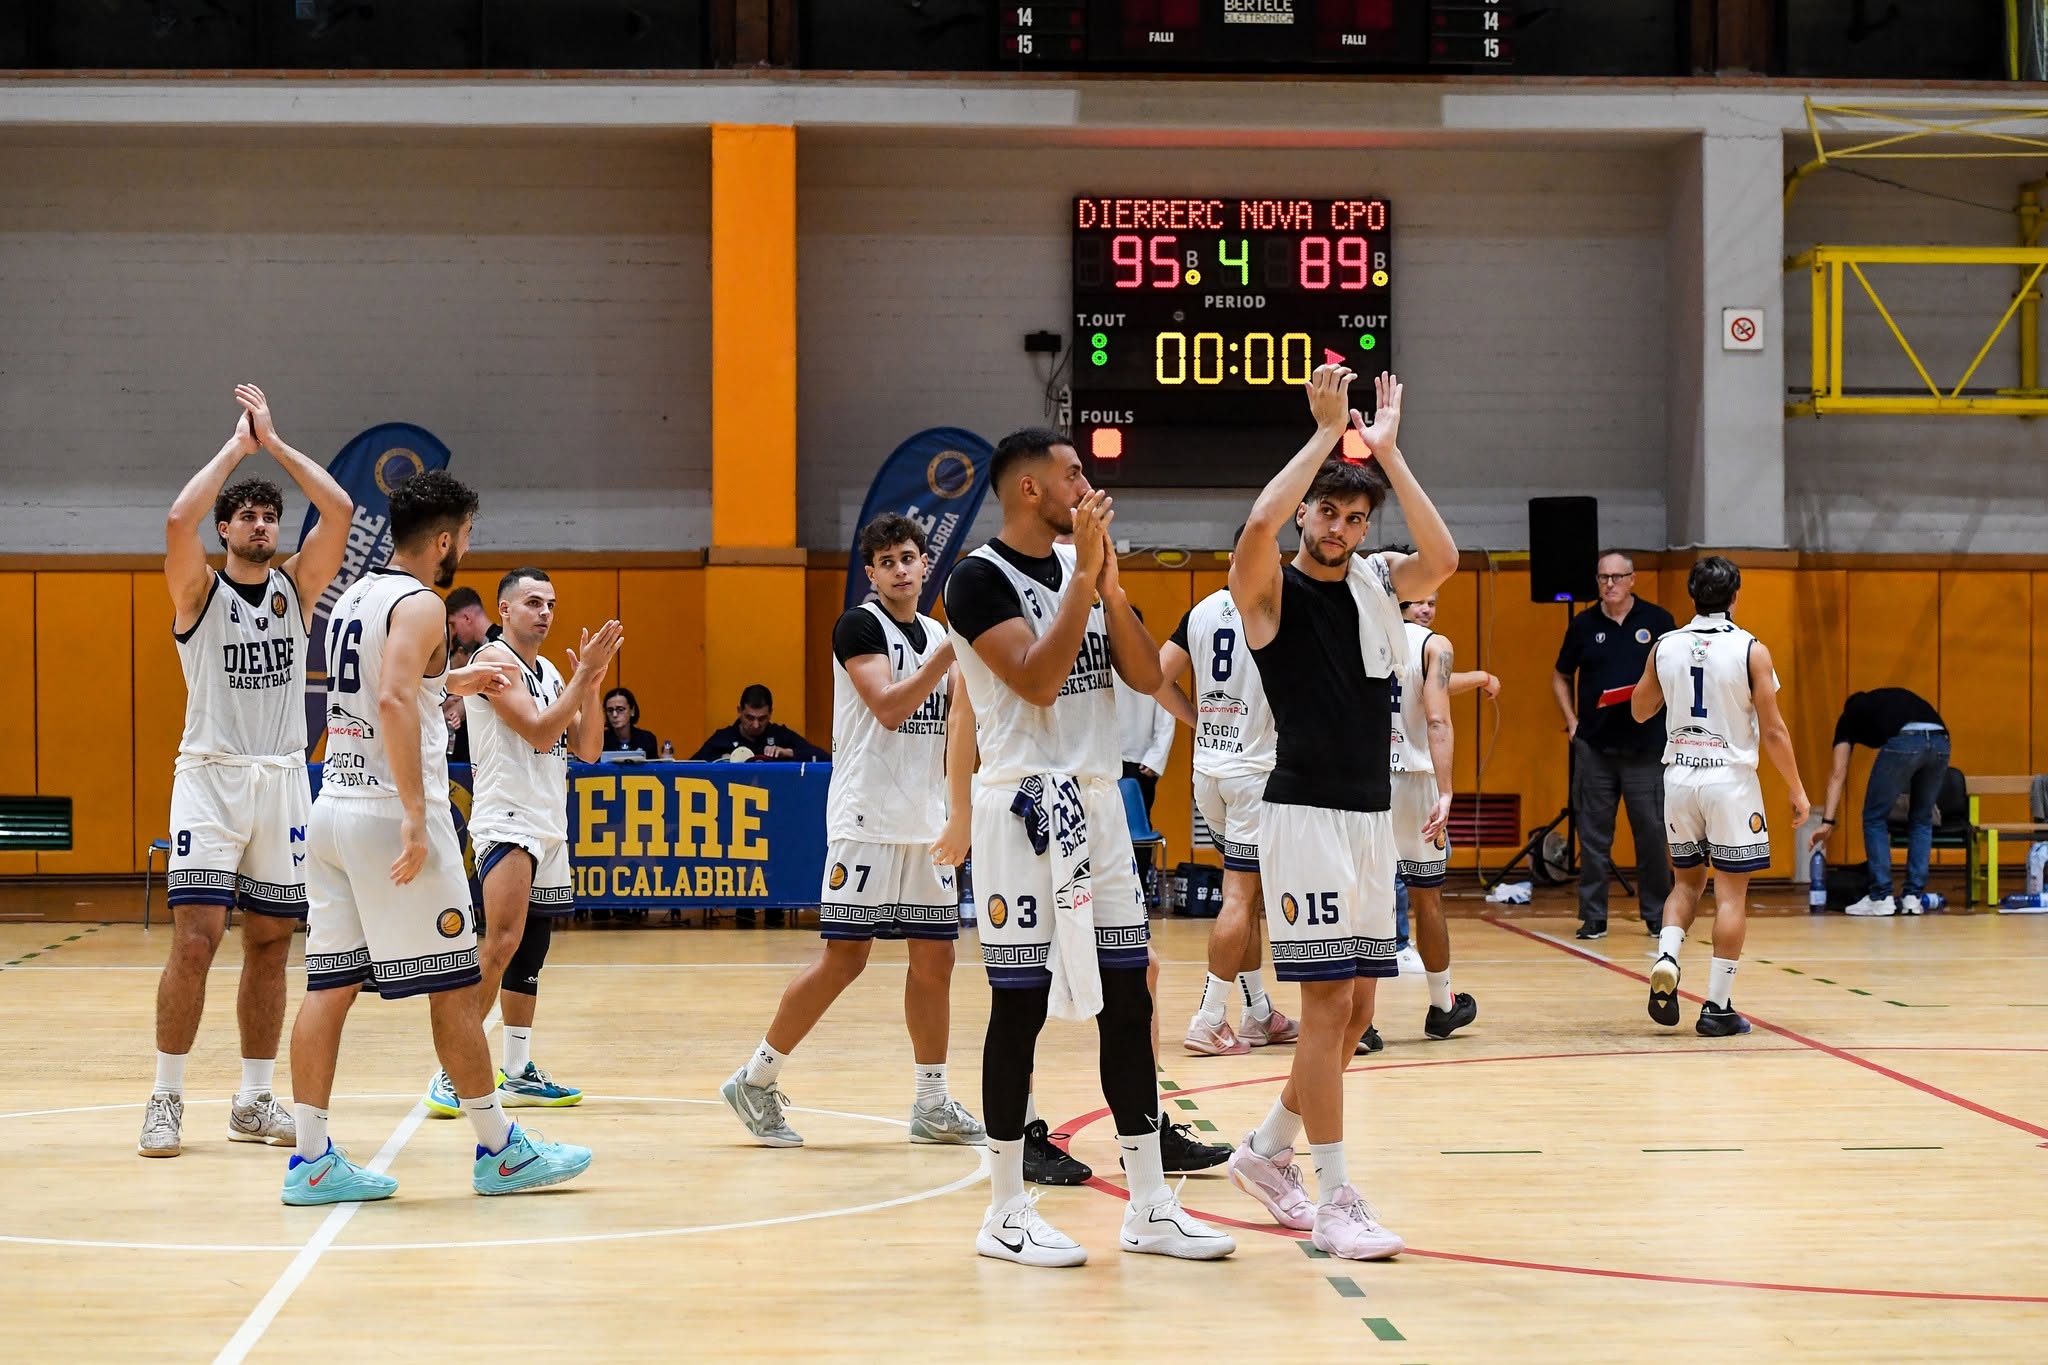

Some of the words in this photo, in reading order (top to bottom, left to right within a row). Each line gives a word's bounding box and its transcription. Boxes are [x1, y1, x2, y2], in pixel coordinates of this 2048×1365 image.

[1017, 8, 1033, 27] 14
[1483, 11, 1499, 30] 14
[1017, 35, 1033, 54] 15
[1149, 32, 1174, 42] FALLI
[1341, 34, 1367, 45] FALLI
[1483, 38, 1499, 58] 15
[1079, 199, 1224, 229] DIERRERC
[1240, 200, 1313, 229] NOVA
[1331, 200, 1385, 230] CPO
[1112, 235, 1180, 288] 95
[1186, 251, 1199, 268] B
[1219, 239, 1249, 286] 4
[1300, 236, 1368, 289] 89
[1374, 252, 1387, 269] B
[1204, 295, 1266, 309] PERIOD
[1077, 314, 1126, 327] T.OUT
[1339, 315, 1388, 328] T.OUT
[1156, 332, 1312, 385] 00:00
[1080, 410, 1134, 424] FOULS
[893, 643, 904, 671] 7
[1212, 628, 1236, 682] 8
[1690, 666, 1707, 718] 1
[566, 775, 768, 861] ERRE
[177, 830, 191, 857] 9
[612, 866, 769, 897] CALABRIA
[855, 865, 871, 892] 7
[1016, 895, 1037, 929] 3
[1306, 891, 1339, 925] 15
